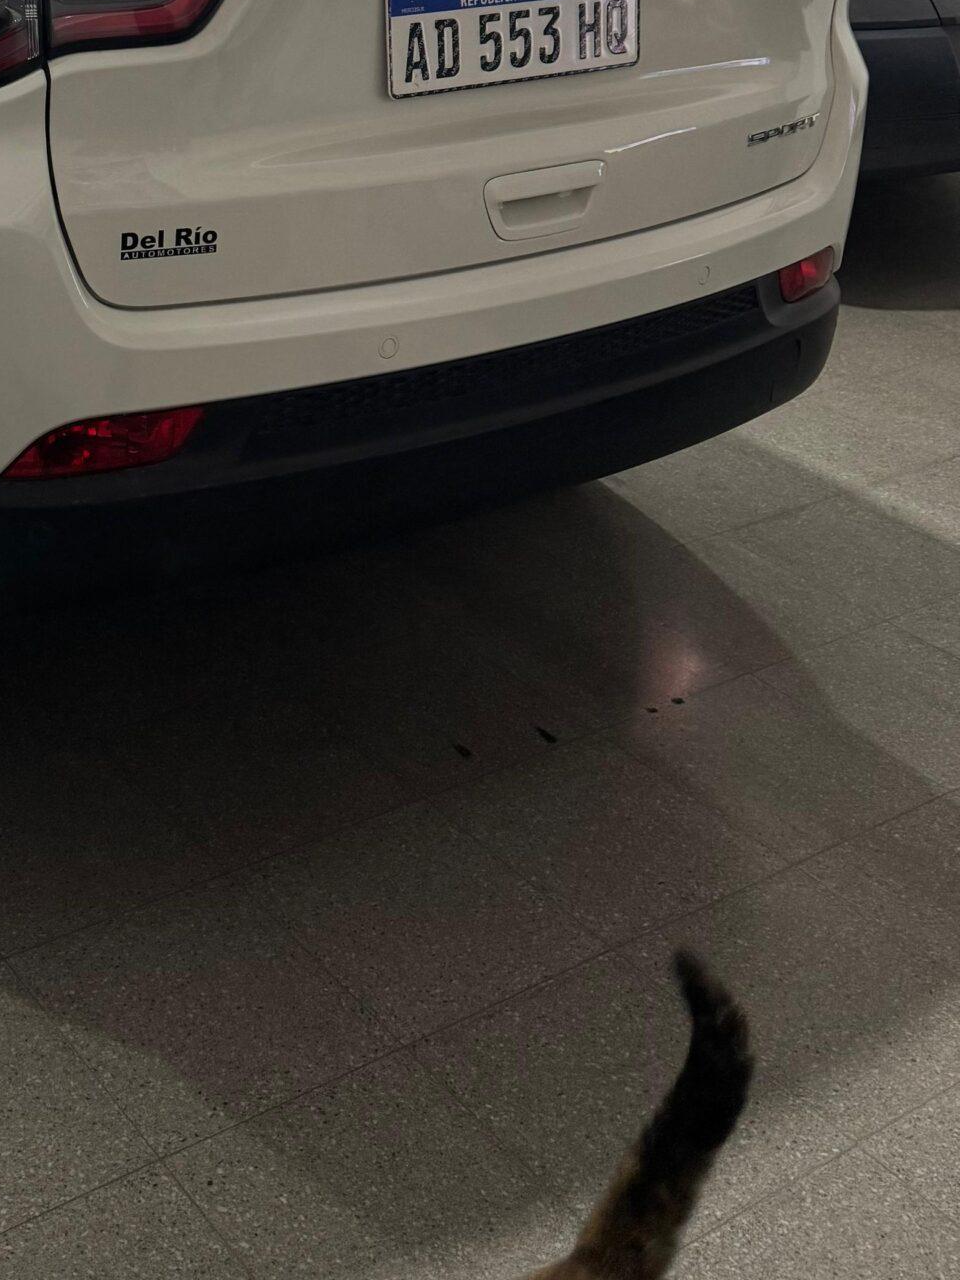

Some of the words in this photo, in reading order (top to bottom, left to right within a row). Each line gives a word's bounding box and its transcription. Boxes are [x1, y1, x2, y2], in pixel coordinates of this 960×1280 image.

[405, 18, 460, 83] AD
[479, 5, 562, 72] 553
[121, 230, 164, 250] Del
[175, 226, 218, 246] Río
[123, 246, 215, 259] AUTOMOTORES
